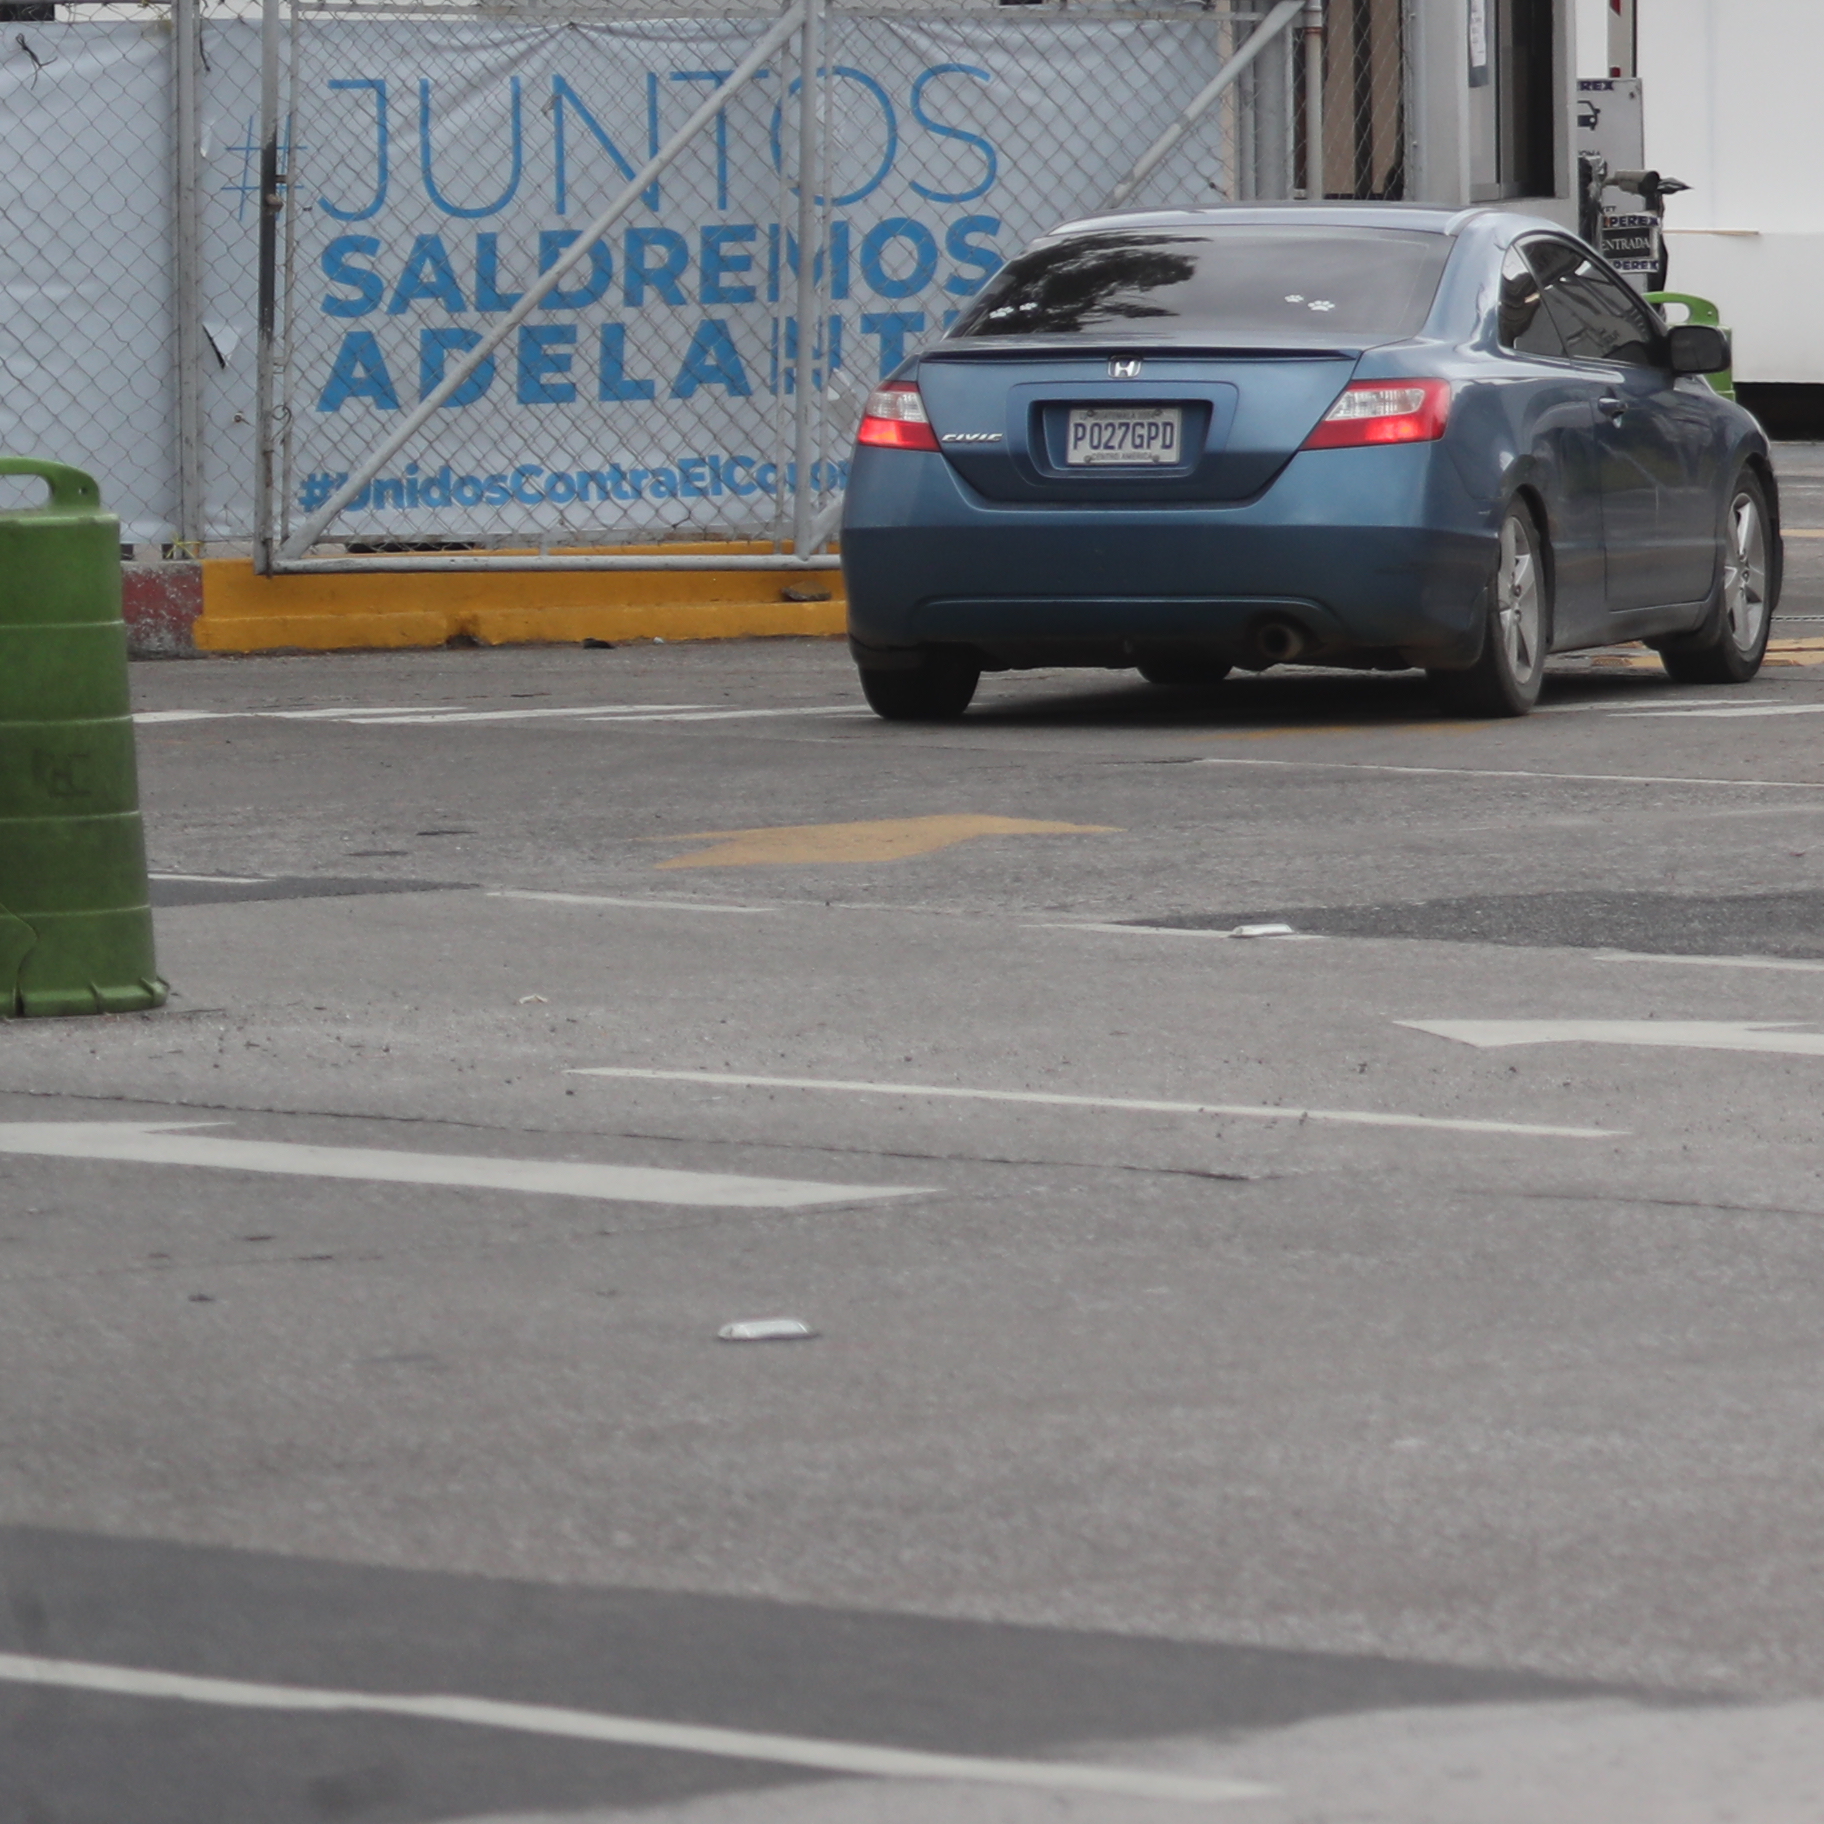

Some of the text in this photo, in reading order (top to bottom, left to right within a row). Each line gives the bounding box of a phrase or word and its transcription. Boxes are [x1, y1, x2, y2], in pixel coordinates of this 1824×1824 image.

[320, 214, 1004, 318] SALDREMOS
[316, 308, 960, 413] ADELANT
[941, 432, 1004, 443] CIVIC
[1073, 421, 1175, 450] P027GPD
